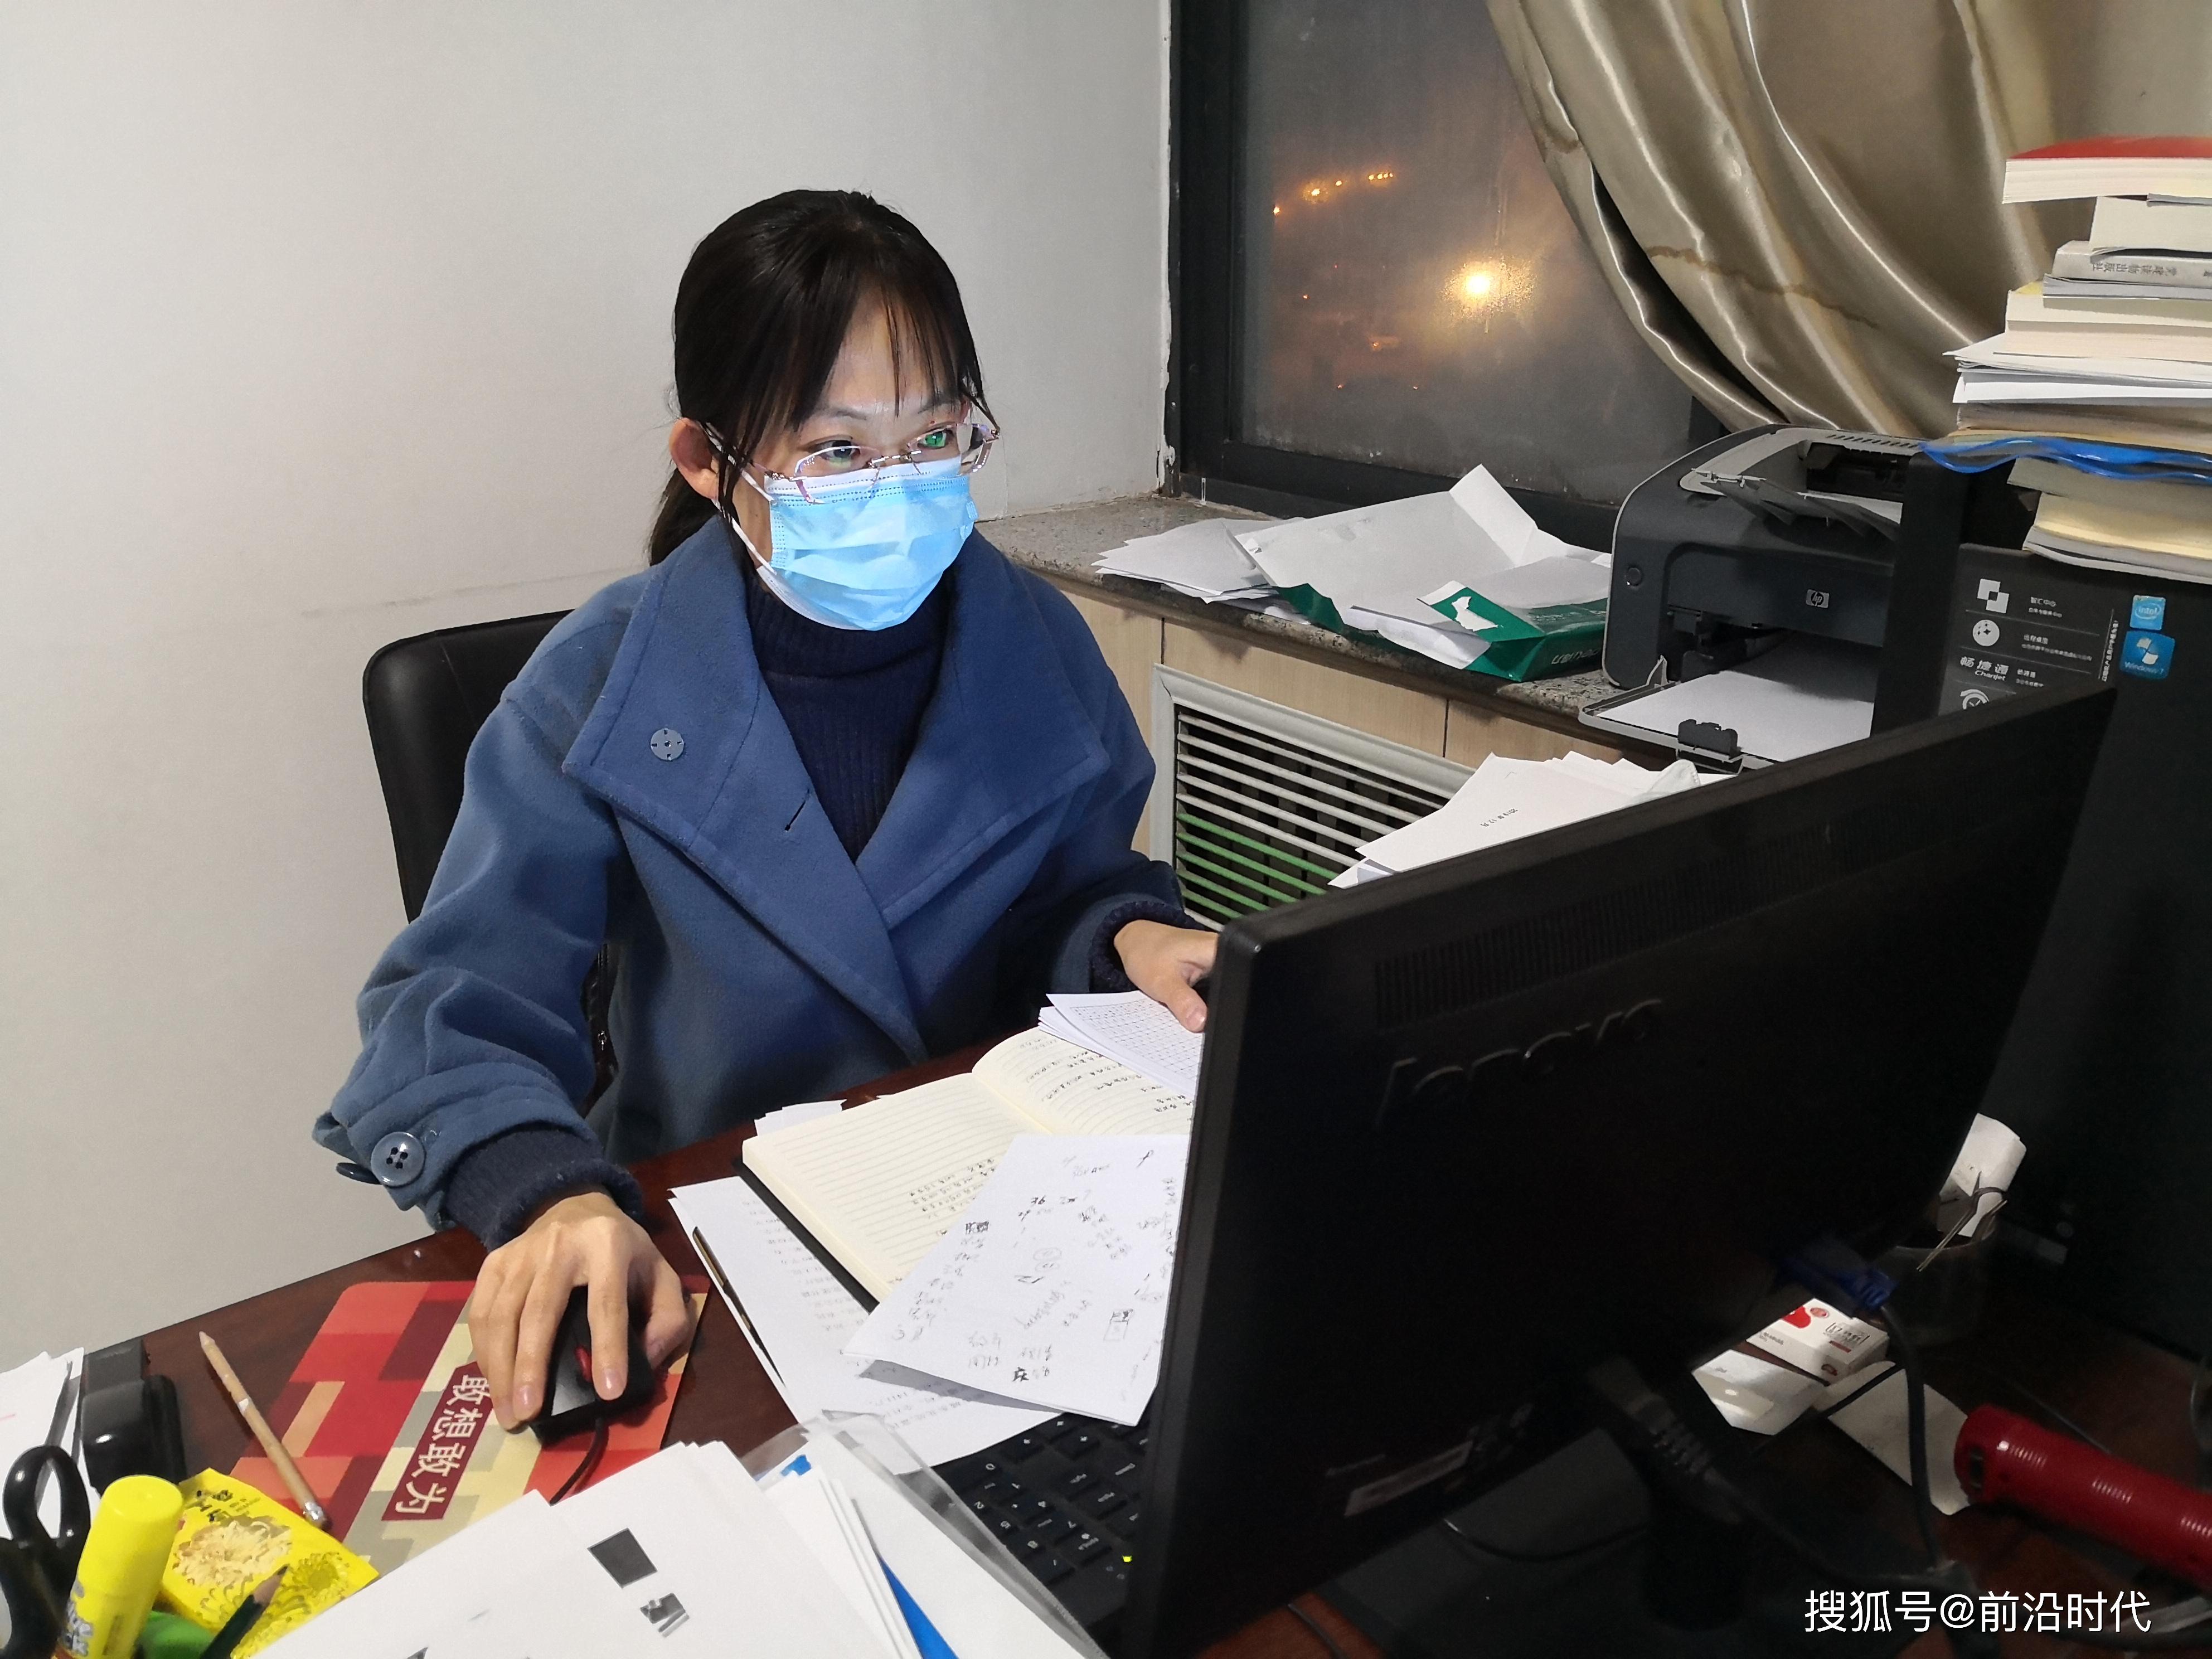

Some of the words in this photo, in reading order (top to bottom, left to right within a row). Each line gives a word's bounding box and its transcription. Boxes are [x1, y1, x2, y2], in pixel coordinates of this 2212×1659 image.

[1959, 656, 2009, 675] 畅捷通
[395, 1374, 490, 1514] 敢想敢为
[974, 1500, 985, 1510] 2
